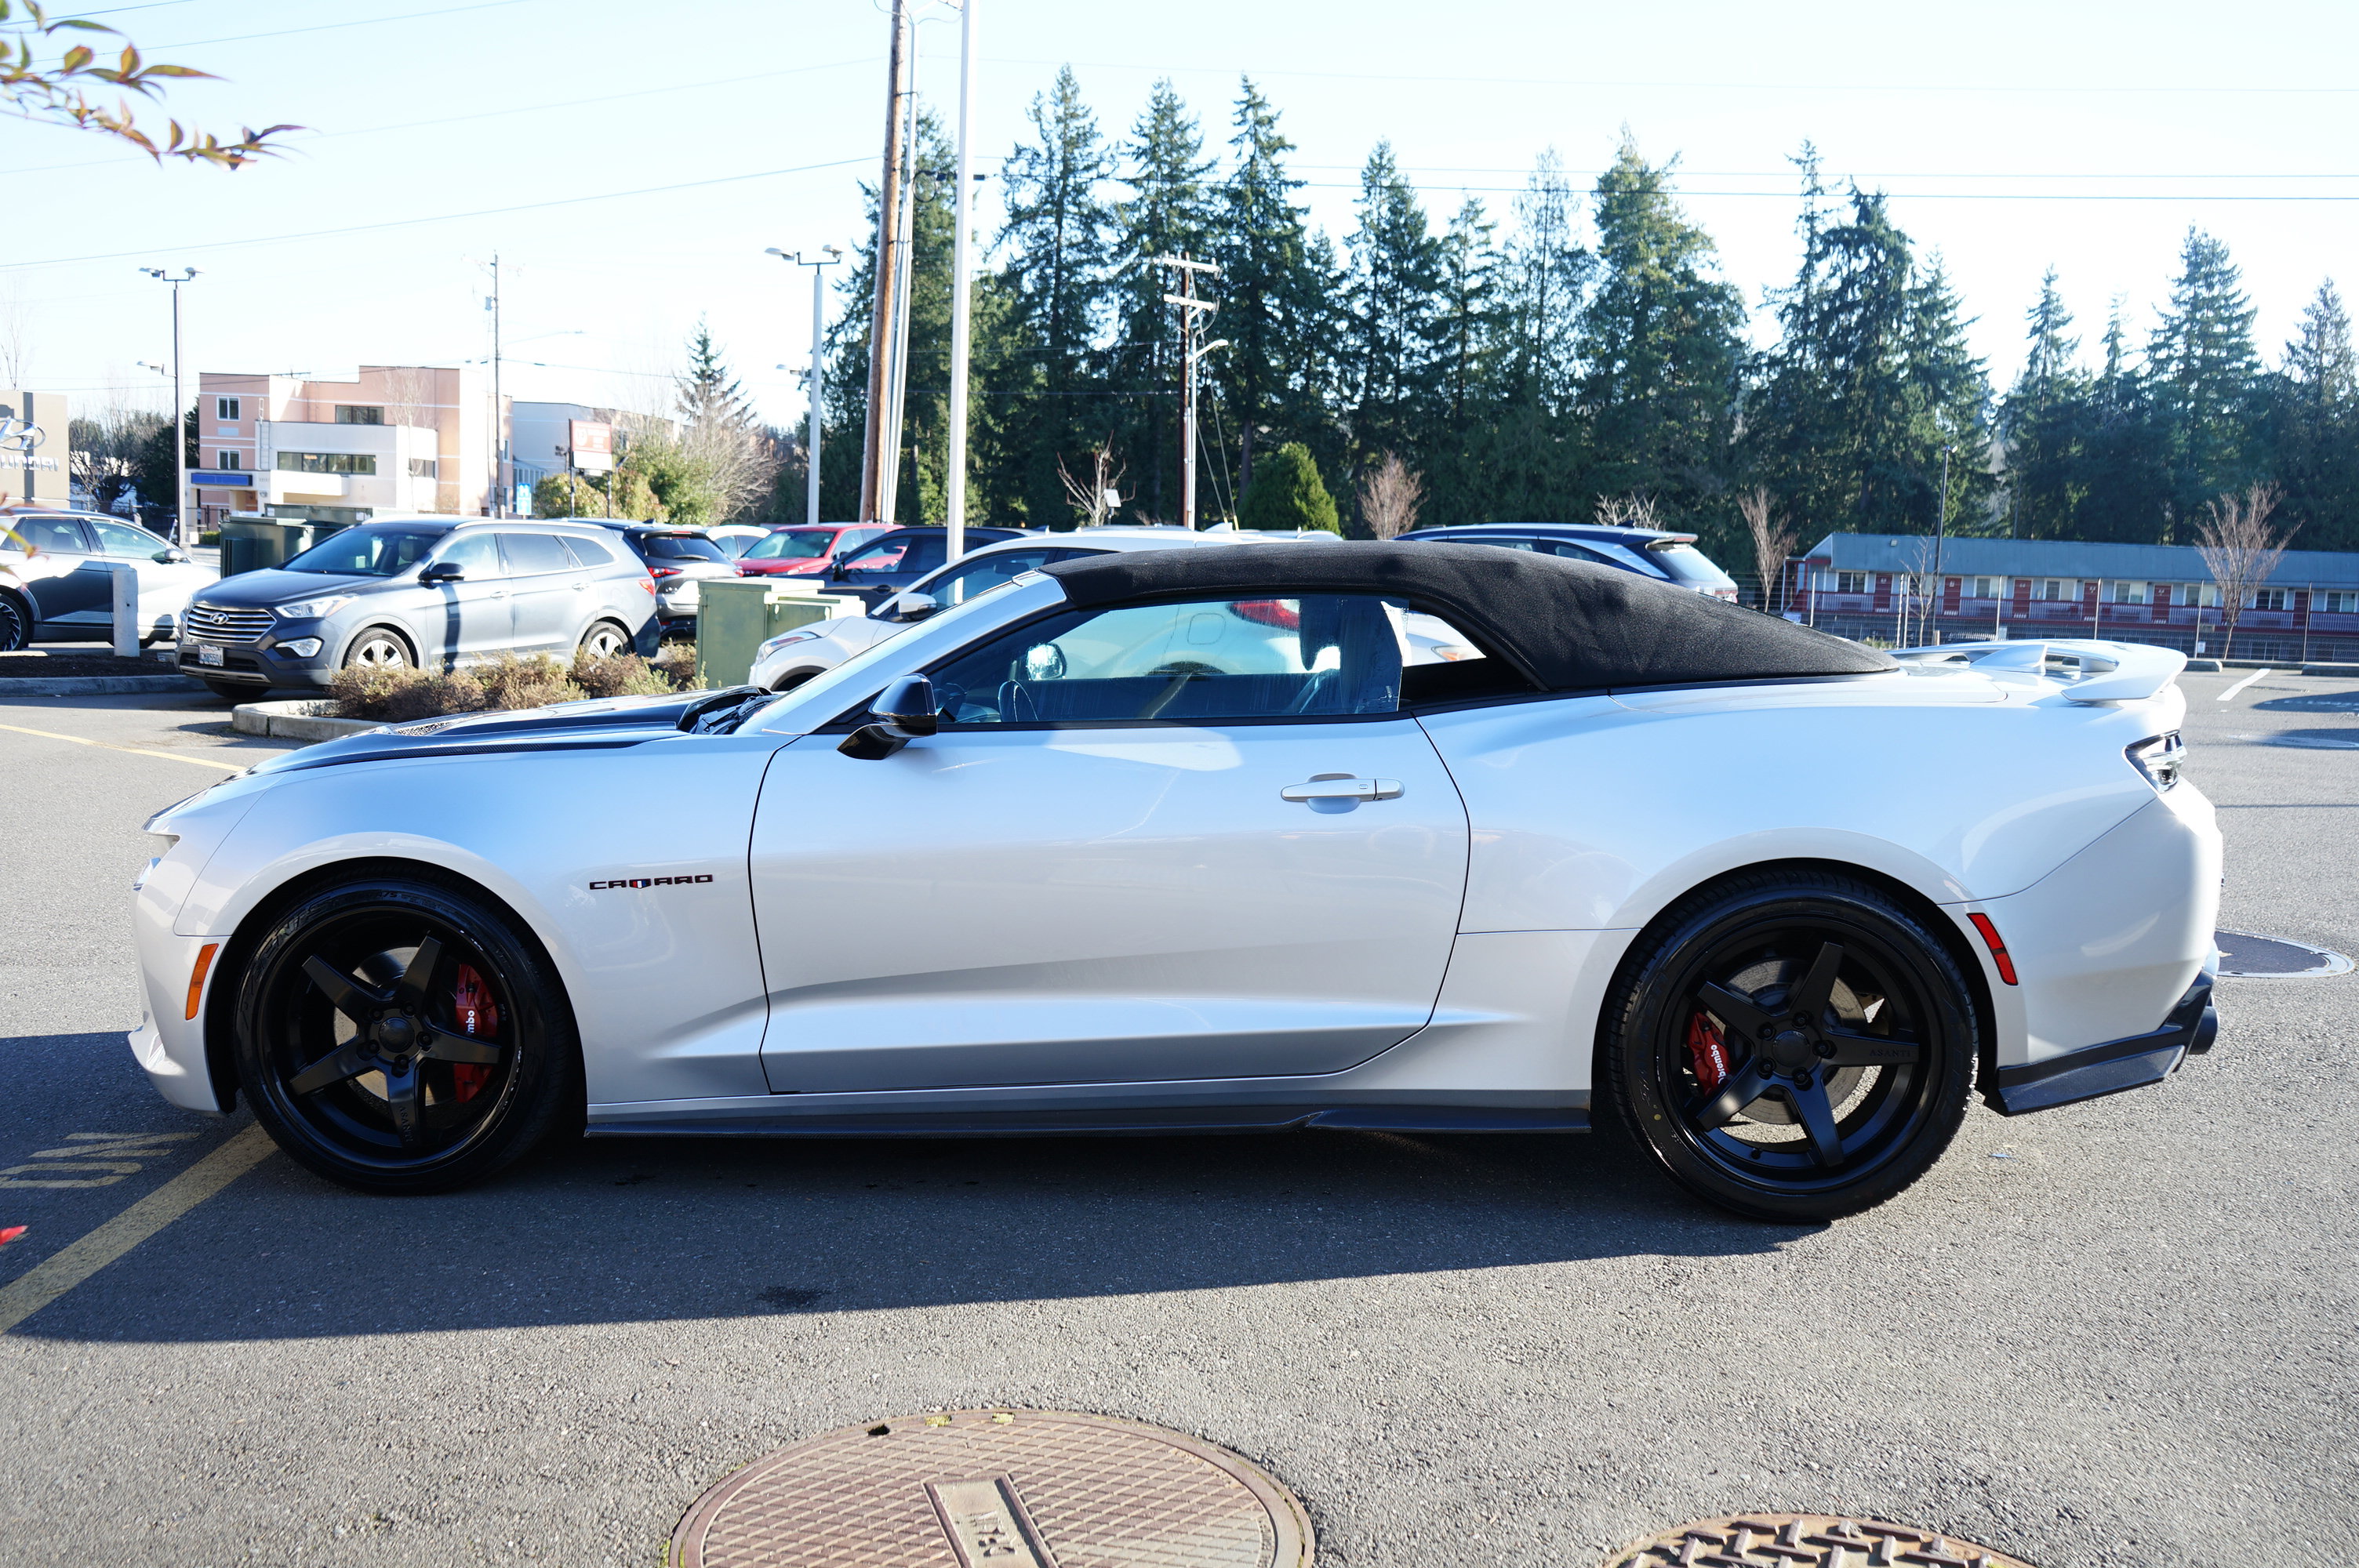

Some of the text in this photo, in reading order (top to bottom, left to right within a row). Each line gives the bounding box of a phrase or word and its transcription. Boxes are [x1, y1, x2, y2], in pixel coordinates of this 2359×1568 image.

[589, 874, 713, 890] CAMARO
[1710, 1044, 1726, 1078] brembo
[1869, 1049, 1911, 1058] ASANTI
